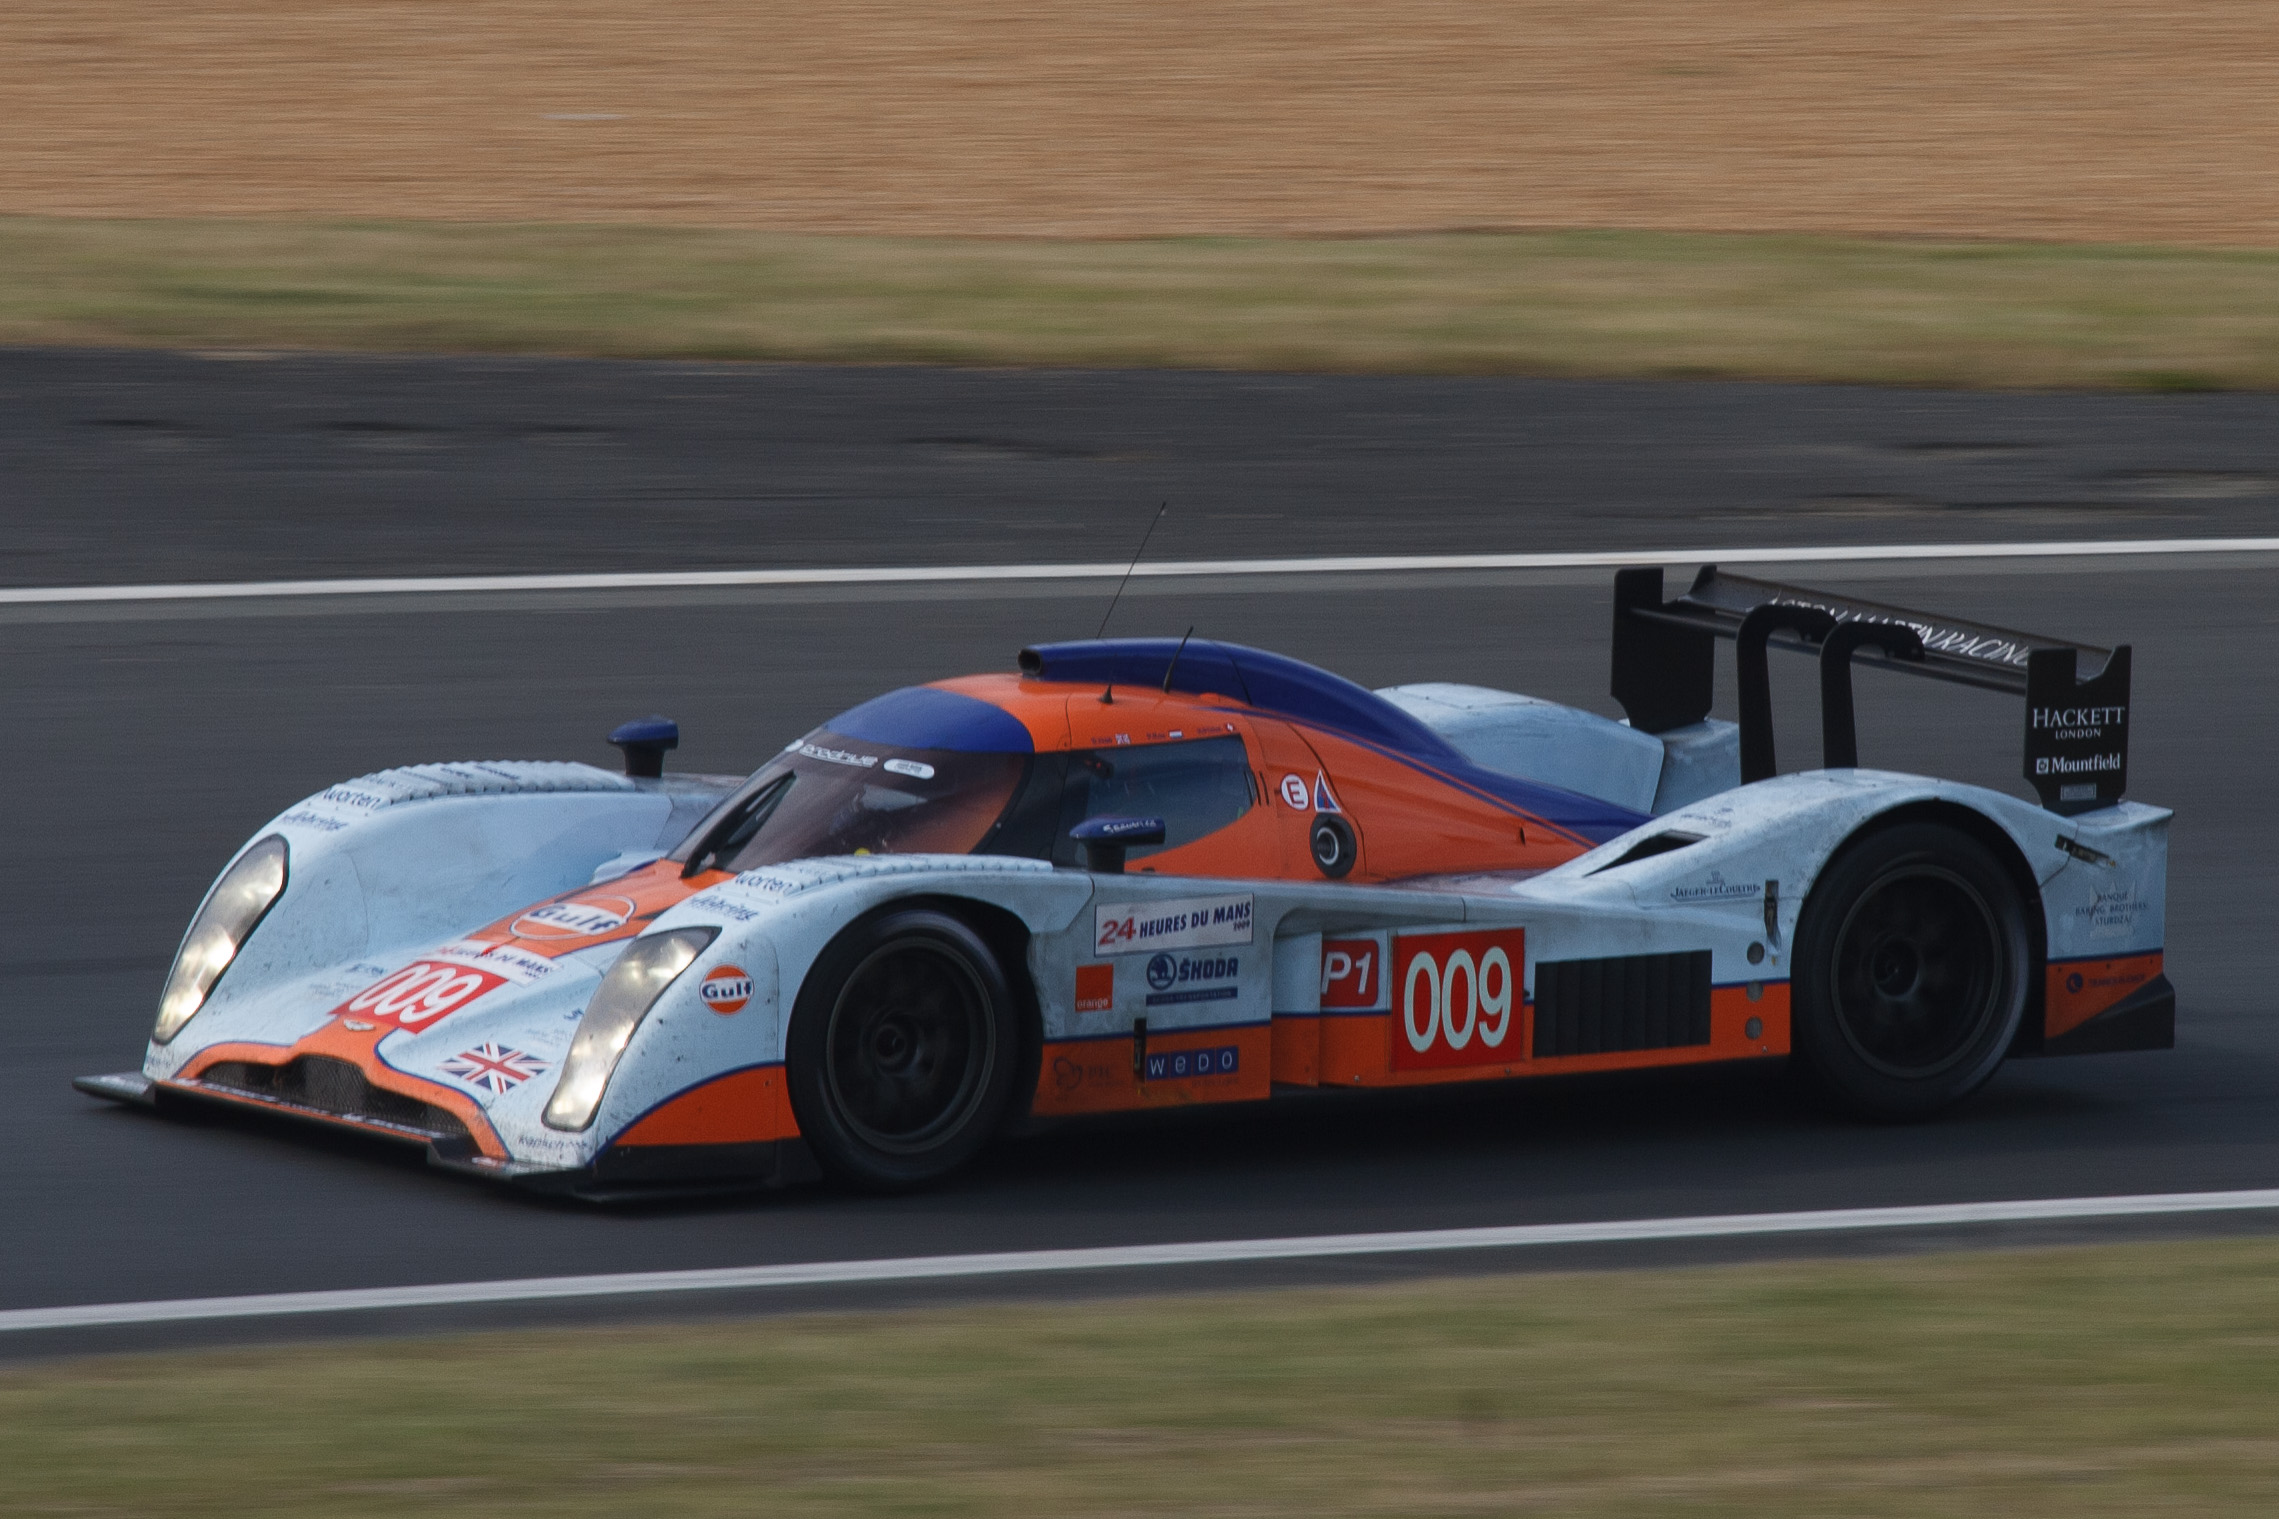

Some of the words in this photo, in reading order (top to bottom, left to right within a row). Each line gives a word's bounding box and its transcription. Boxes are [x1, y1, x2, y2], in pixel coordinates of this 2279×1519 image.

[2033, 706, 2126, 729] HACKETT
[2055, 728, 2101, 740] LONDON
[2051, 752, 2121, 774] Mountfield
[1286, 781, 1305, 805] E
[529, 904, 620, 933] Gulf
[1098, 914, 1137, 947] 24
[1139, 914, 1188, 939] HEURES
[1191, 909, 1210, 929] DU
[1213, 901, 1251, 925] MANS
[1178, 957, 1239, 983] ŠKODA
[1321, 951, 1373, 996] P1
[348, 963, 484, 1024] 009
[701, 980, 752, 999] Gulf
[1403, 946, 1513, 1053] 009
[1076, 998, 1109, 1010] orange
